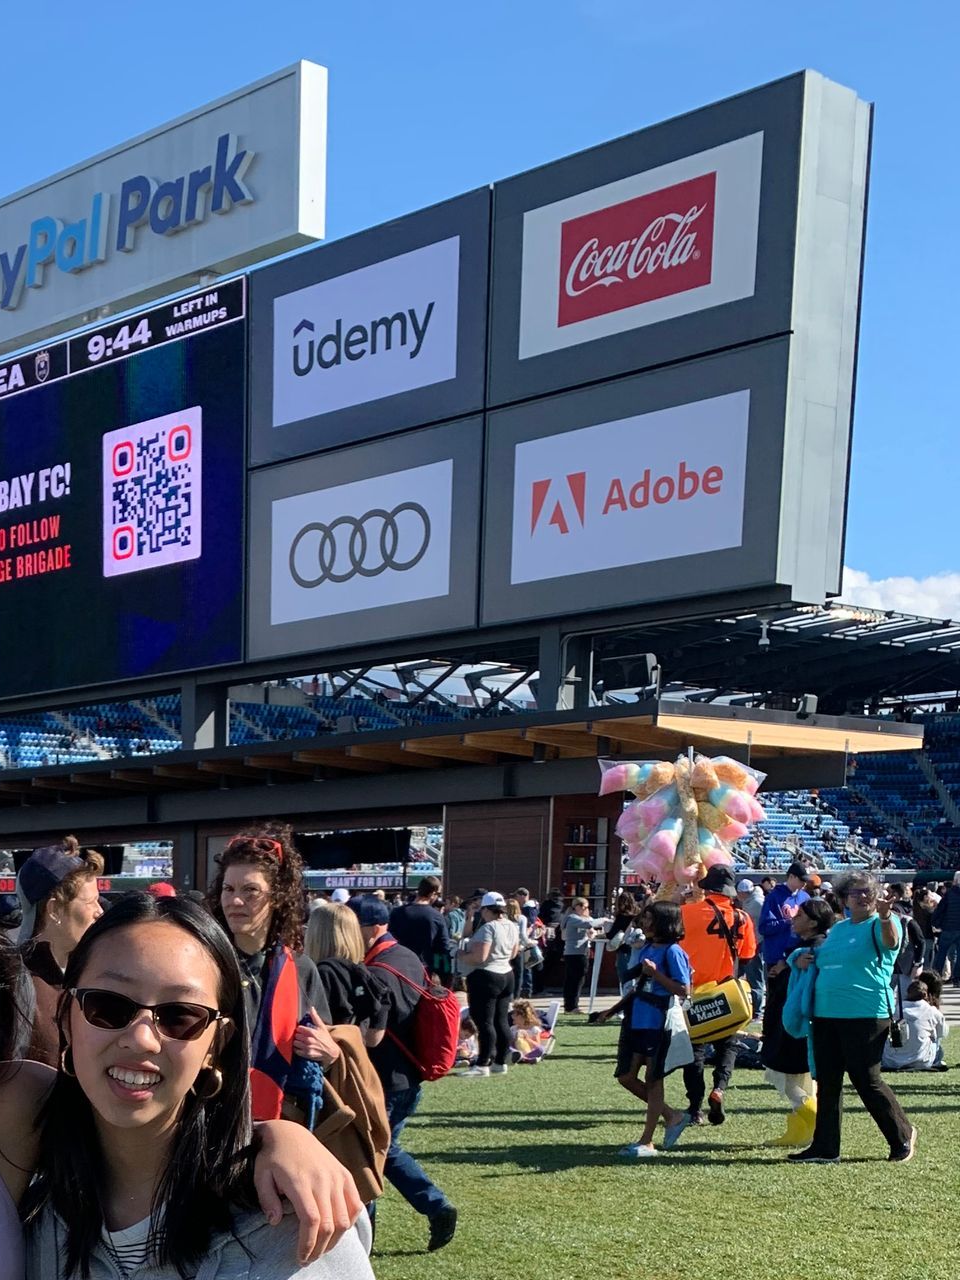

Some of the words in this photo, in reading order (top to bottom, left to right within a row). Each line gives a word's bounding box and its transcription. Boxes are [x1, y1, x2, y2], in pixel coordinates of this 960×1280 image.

[116, 133, 254, 253] Park
[173, 297, 203, 317] LEFT
[205, 291, 218, 306] IN
[165, 307, 227, 337] WARMUPS
[87, 318, 152, 362] 9:44
[39, 462, 71, 502] FC!
[602, 461, 724, 515] Adobe
[10, 515, 60, 548] FOLLOW
[16, 544, 71, 578] BRIGADE
[325, 877, 355, 887] CHANT
[357, 877, 374, 887] FOR
[376, 877, 393, 887] BAY
[690, 999, 724, 1015] Minute
[696, 1007, 722, 1021] Maid
